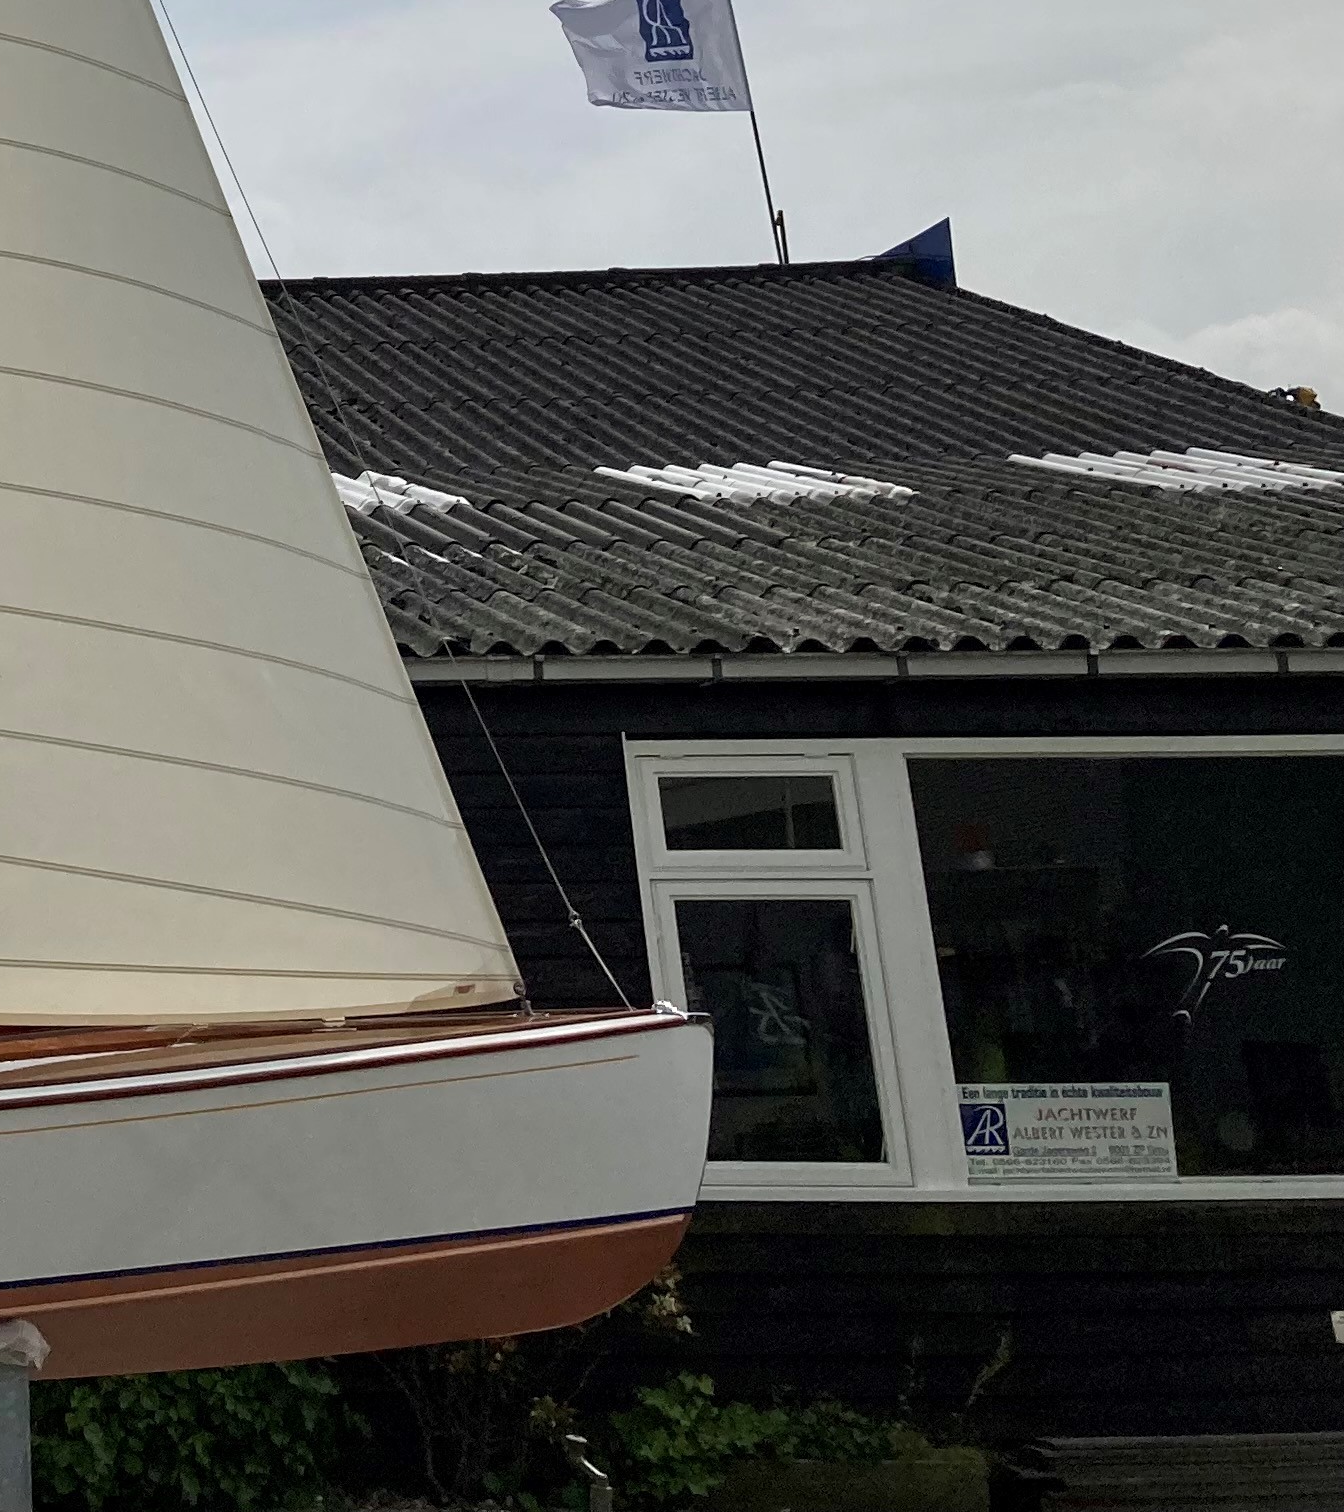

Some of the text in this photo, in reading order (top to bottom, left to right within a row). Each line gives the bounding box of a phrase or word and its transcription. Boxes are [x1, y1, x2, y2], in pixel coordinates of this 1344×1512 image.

[1208, 950, 1246, 979] 75
[1035, 1107, 1138, 1122] JACHTWERF
[1013, 1125, 1064, 1140] ALBERT
[1069, 1125, 1126, 1140] WESTER
